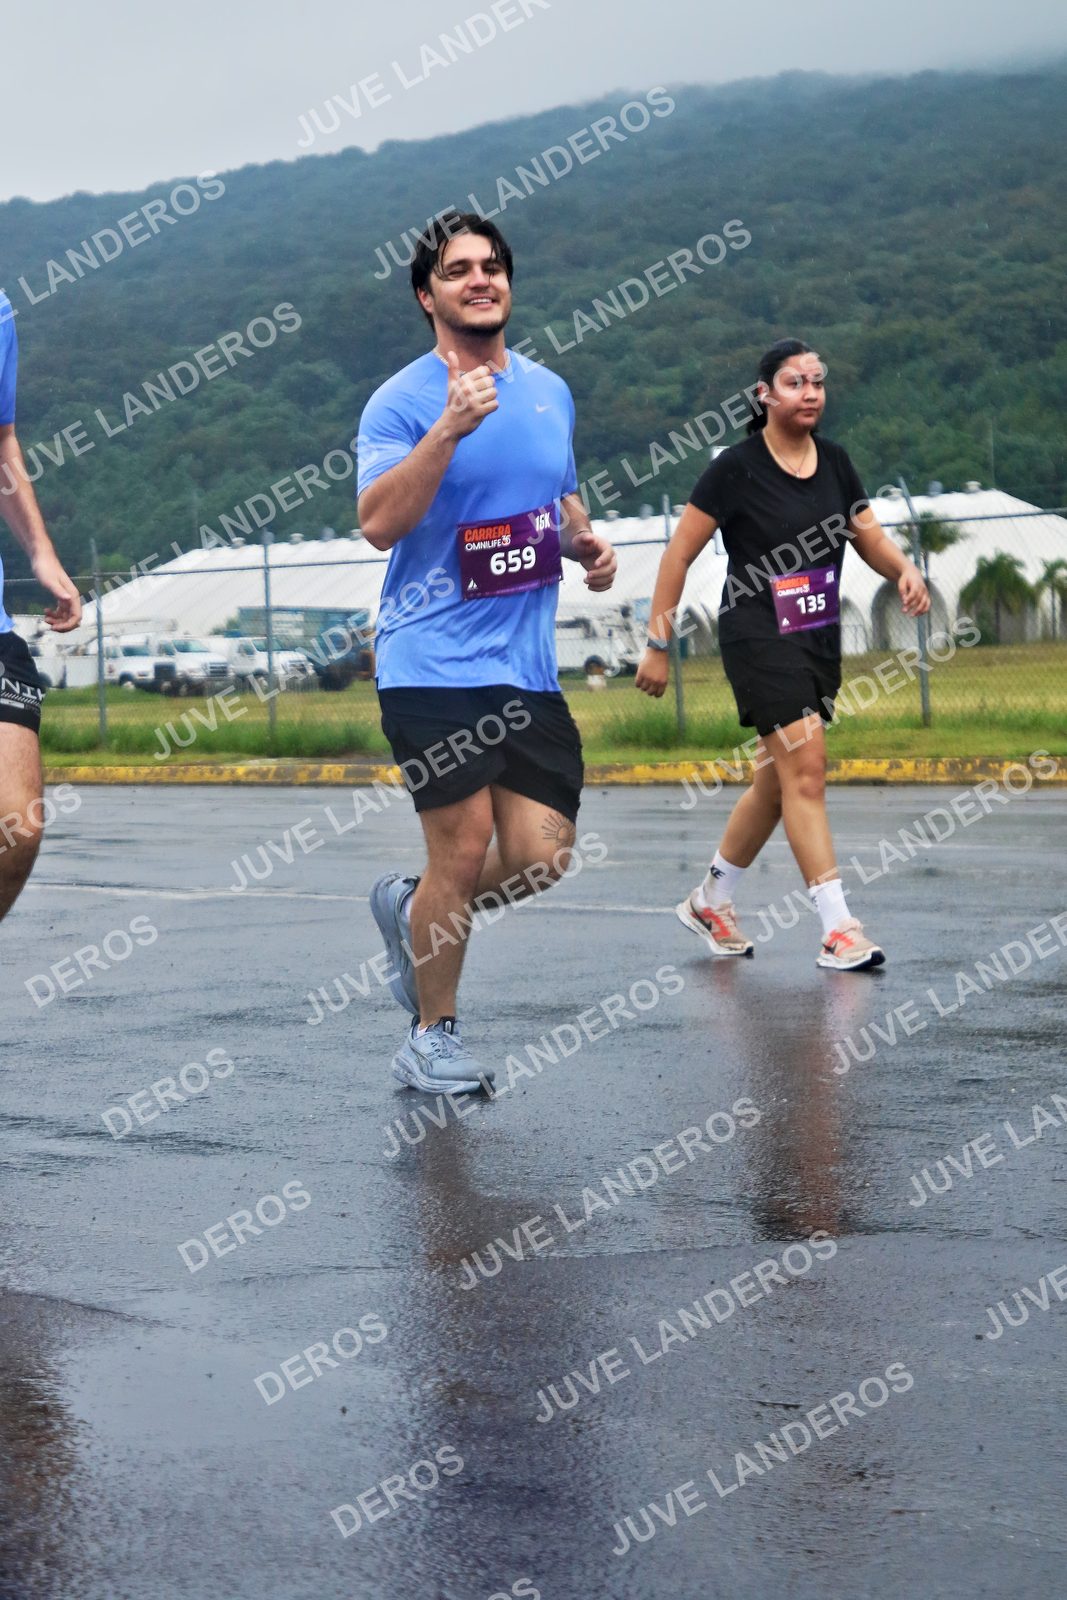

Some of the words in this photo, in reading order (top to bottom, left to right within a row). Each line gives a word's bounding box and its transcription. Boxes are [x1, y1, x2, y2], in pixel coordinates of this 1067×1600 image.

[464, 524, 512, 542] CARRERA
[465, 539, 502, 552] OMNILIFE
[490, 546, 537, 575] 659
[796, 593, 827, 615] 135
